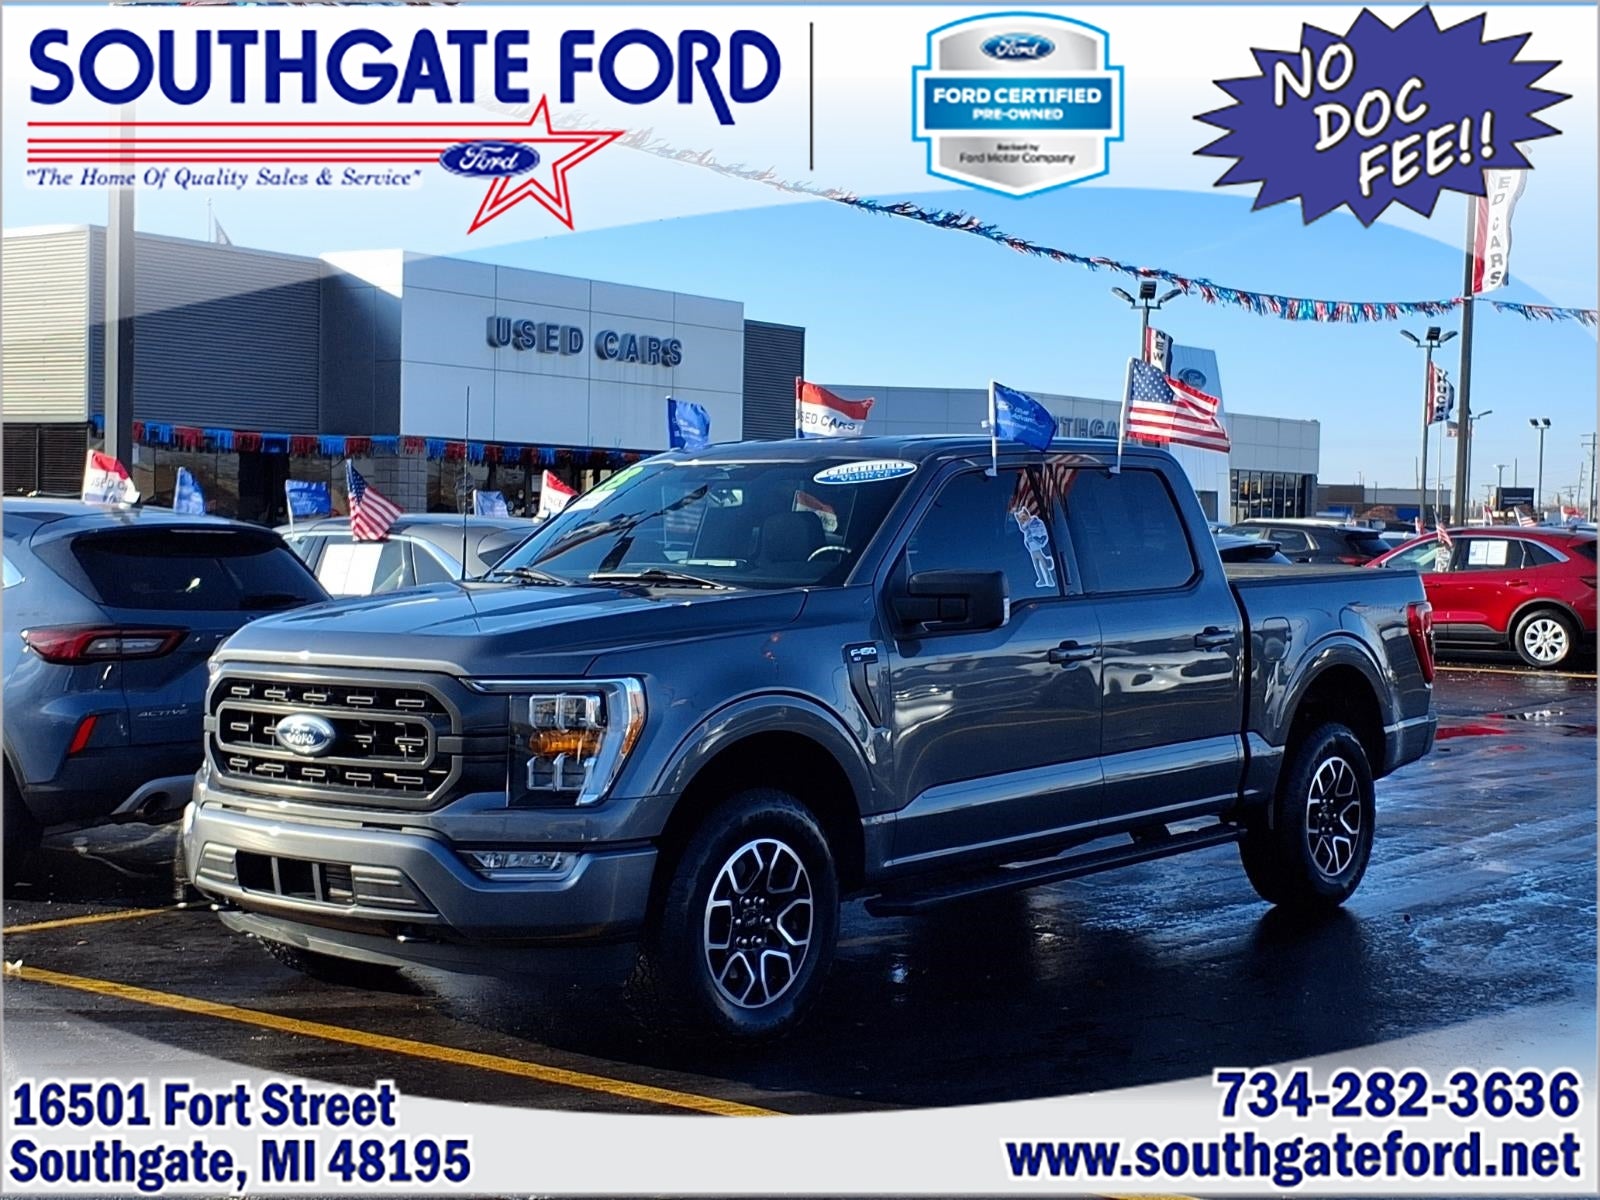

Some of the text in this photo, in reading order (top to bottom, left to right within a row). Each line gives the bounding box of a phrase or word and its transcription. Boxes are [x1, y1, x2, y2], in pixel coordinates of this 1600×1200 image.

[486, 316, 682, 367] USED CARS
[1153, 330, 1166, 361] NEW
[820, 414, 856, 431] CARS
[850, 646, 877, 657] F-150
[285, 723, 318, 746] Ford
